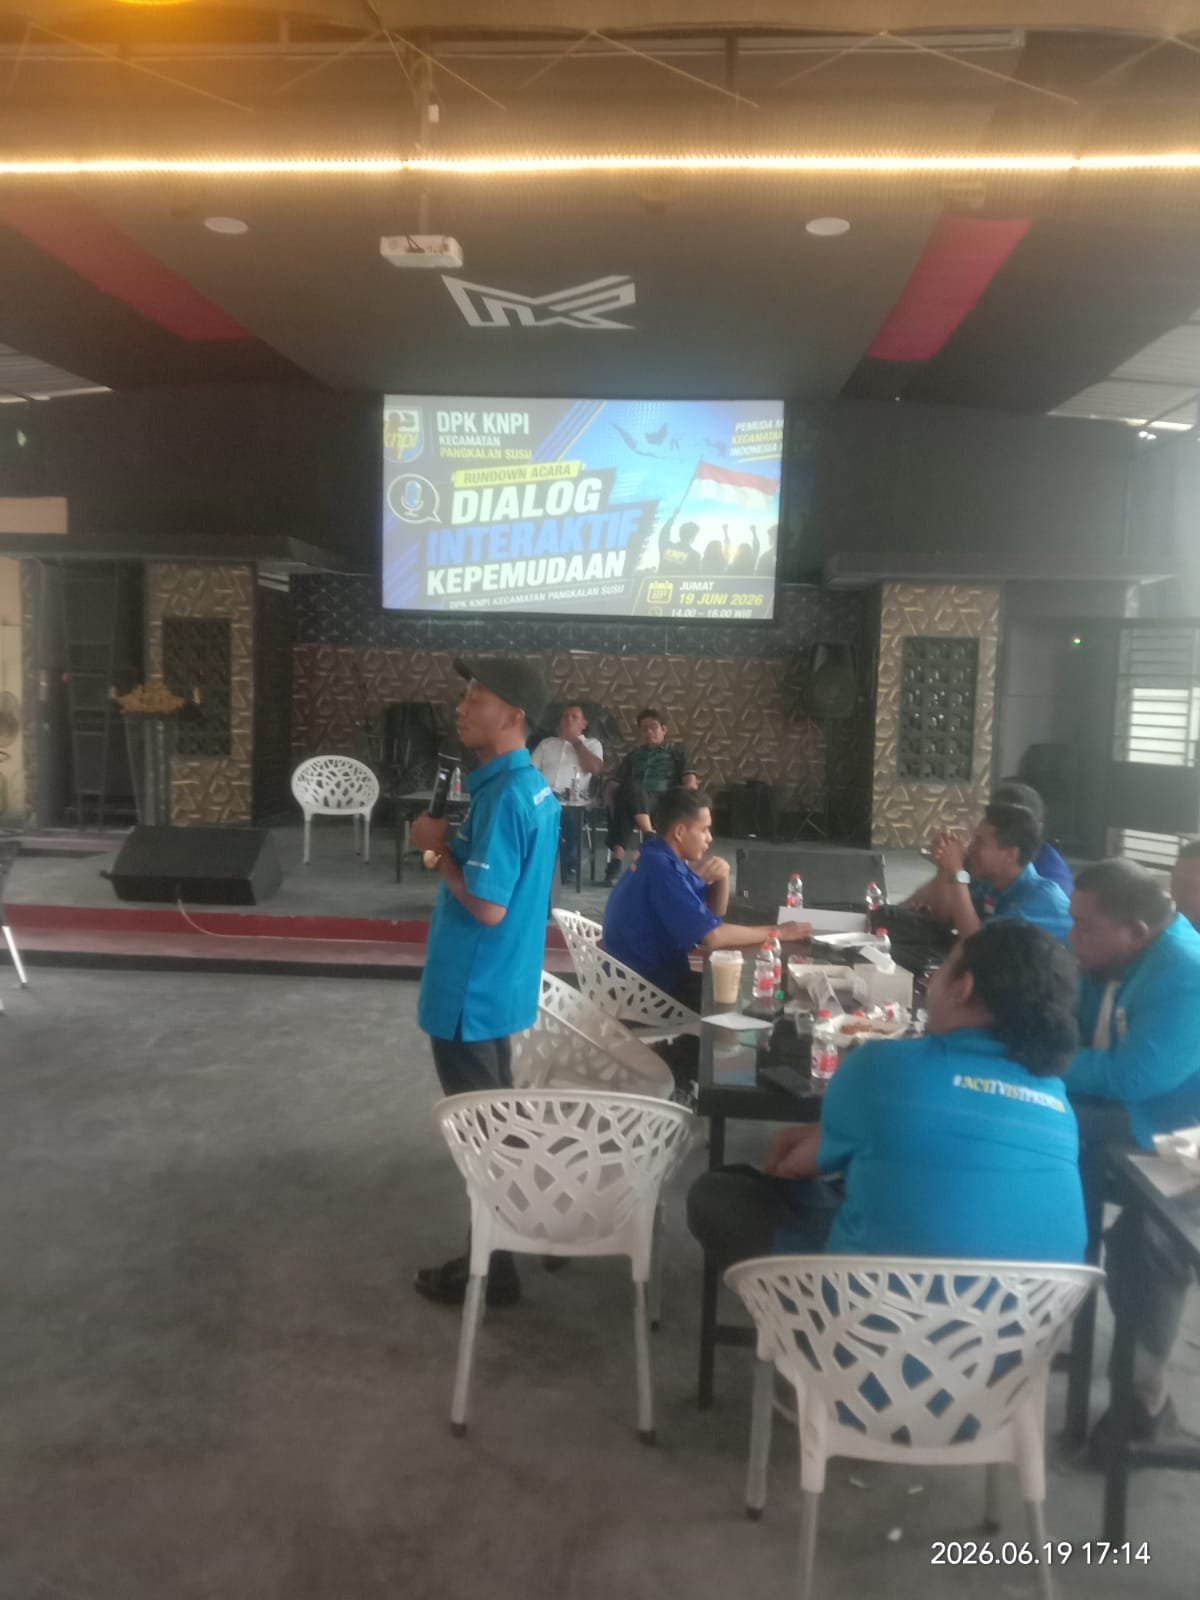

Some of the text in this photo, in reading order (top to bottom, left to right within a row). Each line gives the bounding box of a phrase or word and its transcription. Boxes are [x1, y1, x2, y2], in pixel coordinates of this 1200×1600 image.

[437, 411, 530, 434] DPK KNPI
[439, 435, 501, 447] KECAMATAN
[440, 448, 532, 460] PANGKALAN SUSU
[464, 464, 571, 485] RUNDOWN ACARA
[452, 477, 602, 525] DIALOG
[427, 509, 643, 566] INTERAKTIF
[427, 550, 627, 596] KEPEMUDAAN
[493, 593, 545, 606] KECAMATAN
[548, 587, 599, 600] PANGKALAN
[601, 584, 624, 595] SUSU
[680, 581, 715, 591] JUMAT
[680, 593, 764, 606] 19 JUNI 2026
